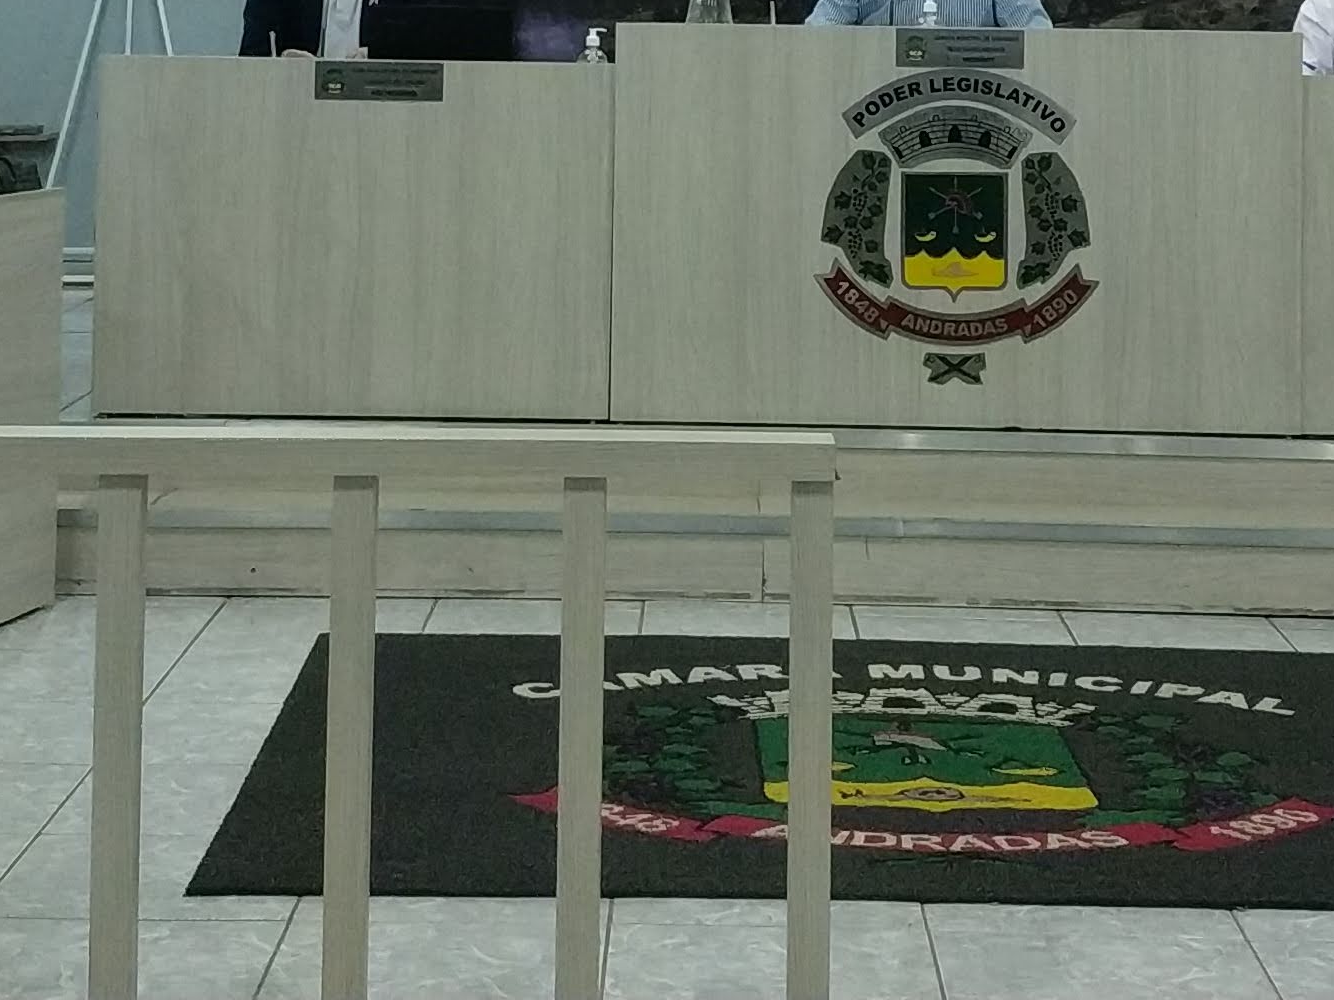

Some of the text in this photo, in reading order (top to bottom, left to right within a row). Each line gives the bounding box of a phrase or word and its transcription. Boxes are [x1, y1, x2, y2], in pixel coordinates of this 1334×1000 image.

[852, 77, 1066, 133] PODER LEGISLATIVO
[838, 281, 1079, 337] 1848 ANDRADAS 1890
[513, 663, 1296, 716] CMAR MUNICIPAL
[1210, 808, 1319, 841] 1890
